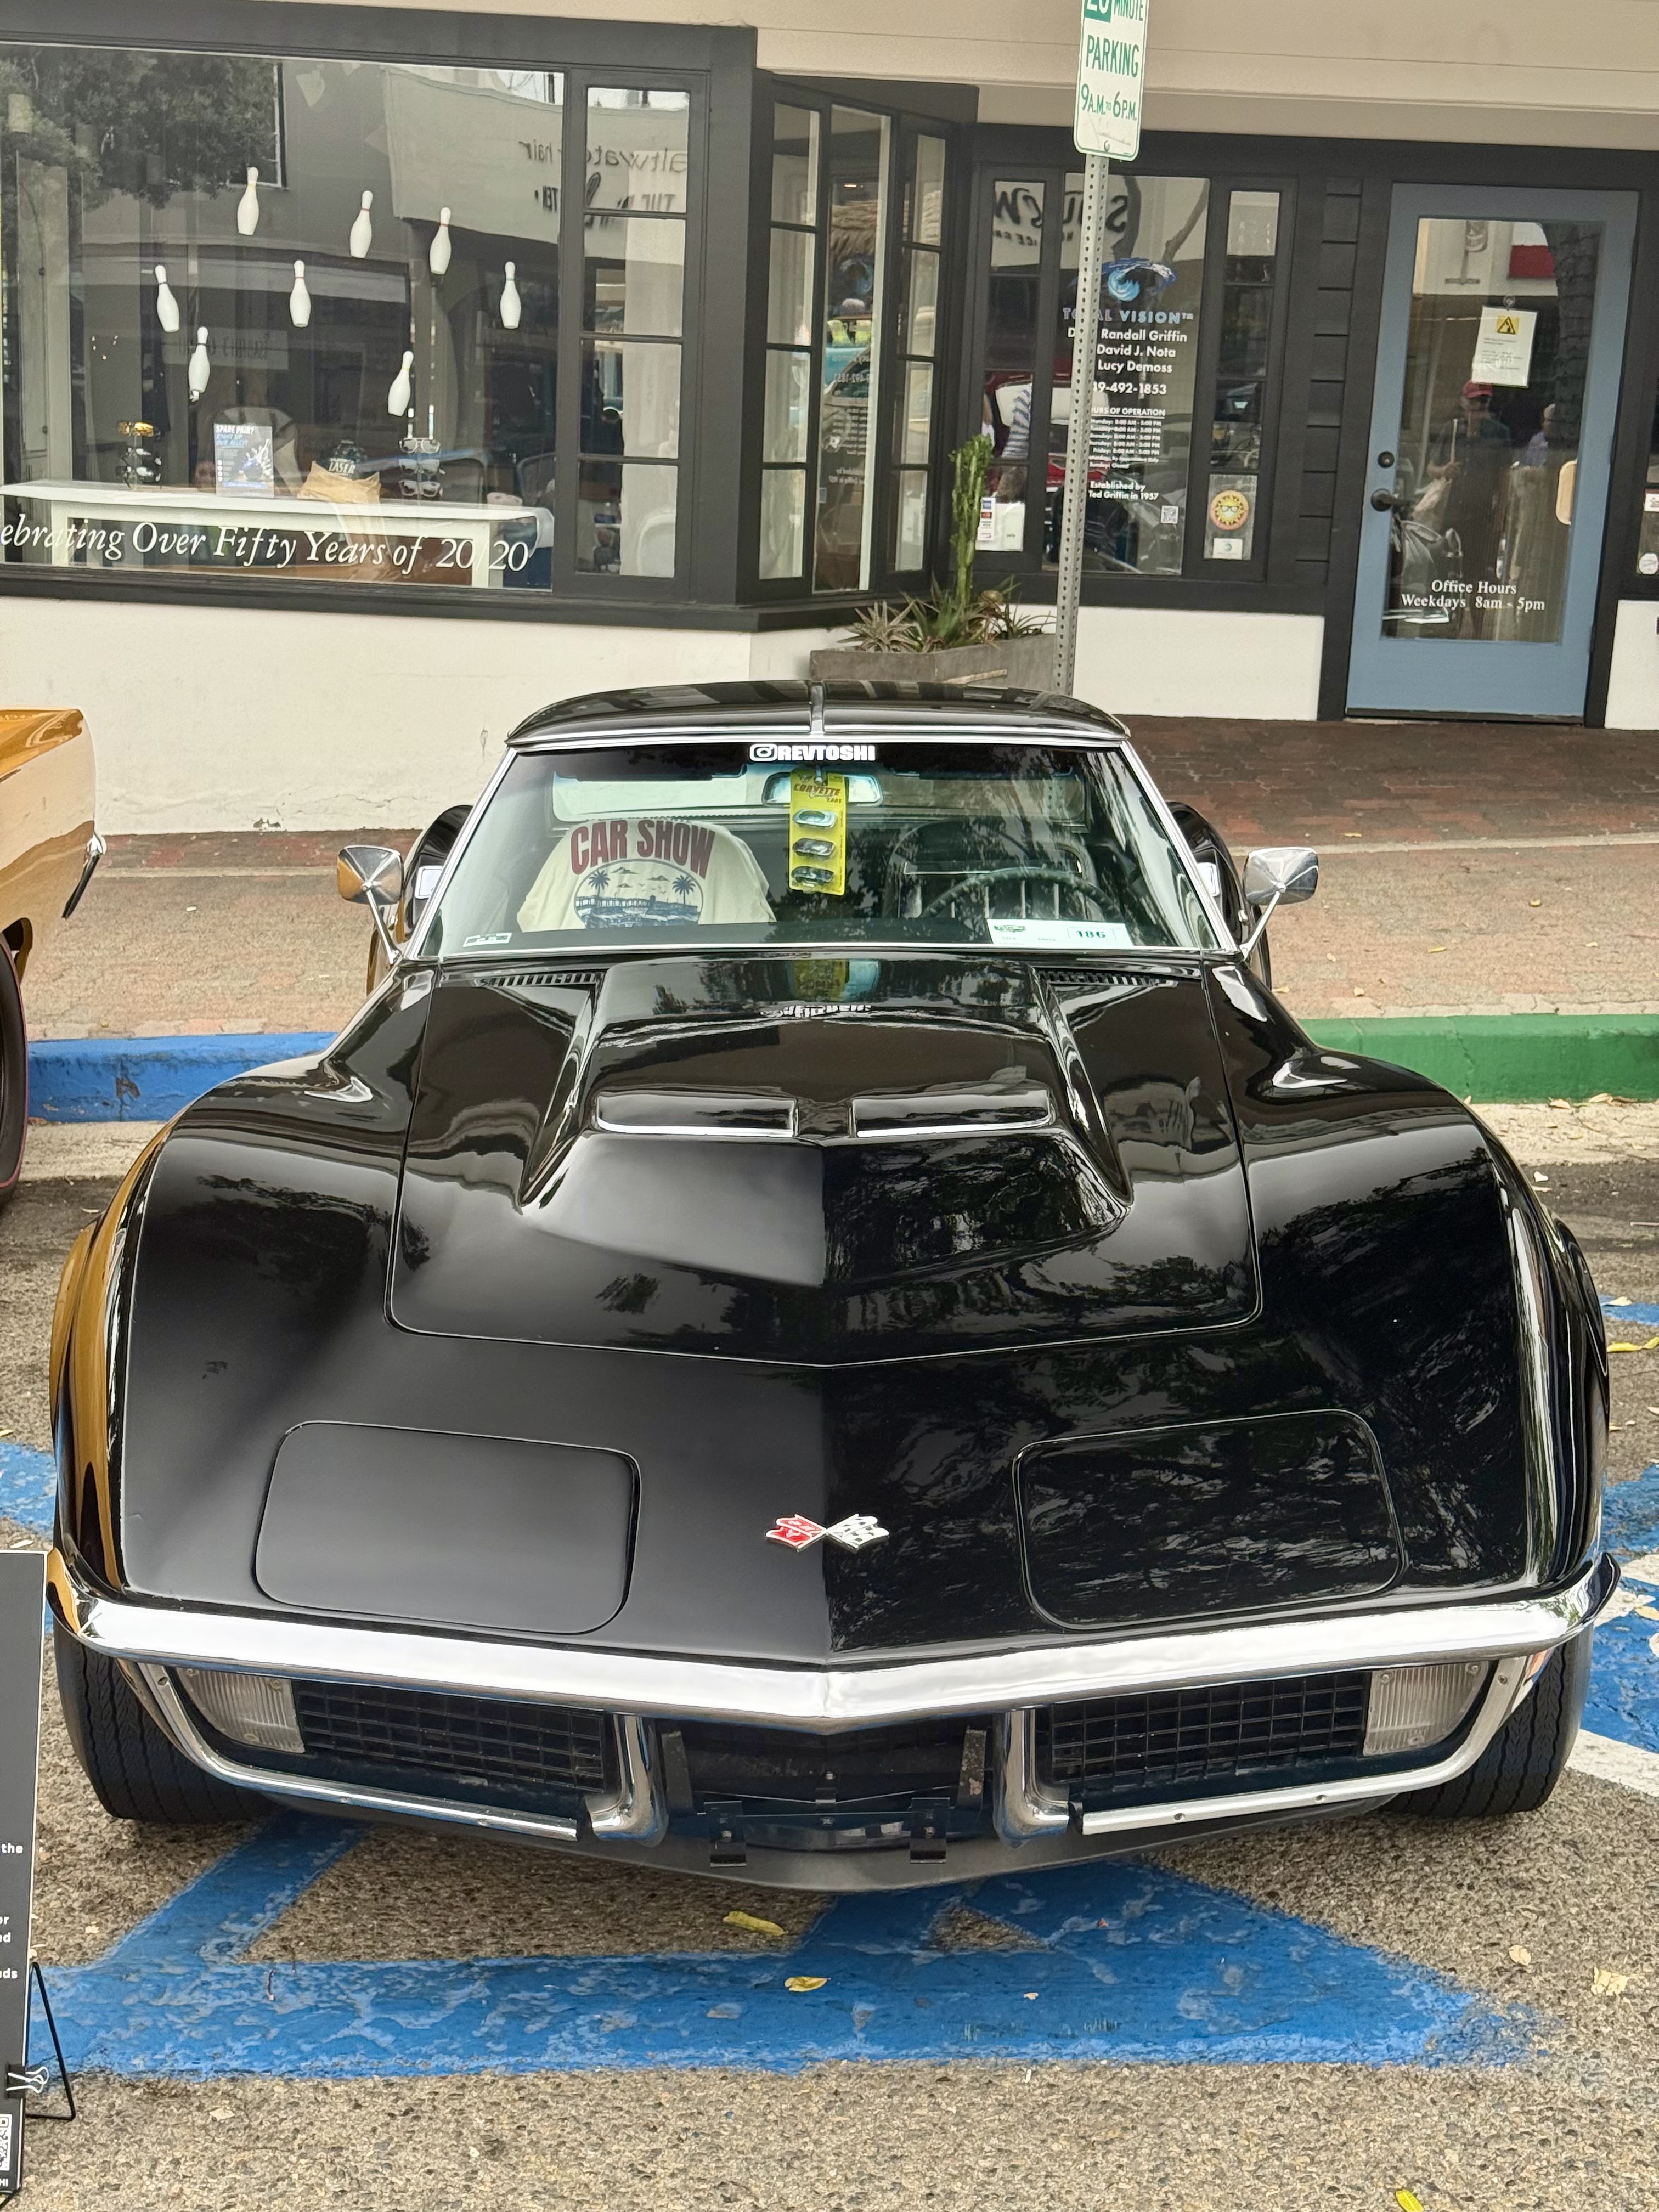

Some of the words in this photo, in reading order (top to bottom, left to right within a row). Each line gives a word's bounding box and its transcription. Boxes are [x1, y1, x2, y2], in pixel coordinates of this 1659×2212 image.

[1086, 35, 1139, 78] PARKING
[1101, 328, 1146, 341] Randall
[1149, 330, 1187, 342] Griffin
[1097, 344, 1131, 356] David
[1133, 345, 1143, 356] J.
[1147, 346, 1176, 358] Nota
[1098, 359, 1124, 374] Lucy
[1127, 360, 1172, 373] Demoss
[1121, 408, 1166, 416] OPERATION
[216, 425, 236, 433] SPARE
[1090, 481, 1134, 489] Established
[1135, 483, 1146, 492] by
[1104, 491, 1129, 499] Griffin
[132, 522, 206, 555] Over
[213, 526, 297, 568] Fifty
[303, 531, 386, 565] Years
[393, 534, 428, 575] of
[1431, 579, 1473, 592] Office
[1477, 580, 1517, 594] Hours
[1401, 594, 1466, 610] Weekdays
[1475, 596, 1502, 609] 8am
[1516, 597, 1545, 613] 5pm
[778, 744, 876, 761] REVTOSHI
[571, 820, 628, 876] CAR
[637, 820, 716, 880] SHOW
[1, 1842, 24, 1854] the
